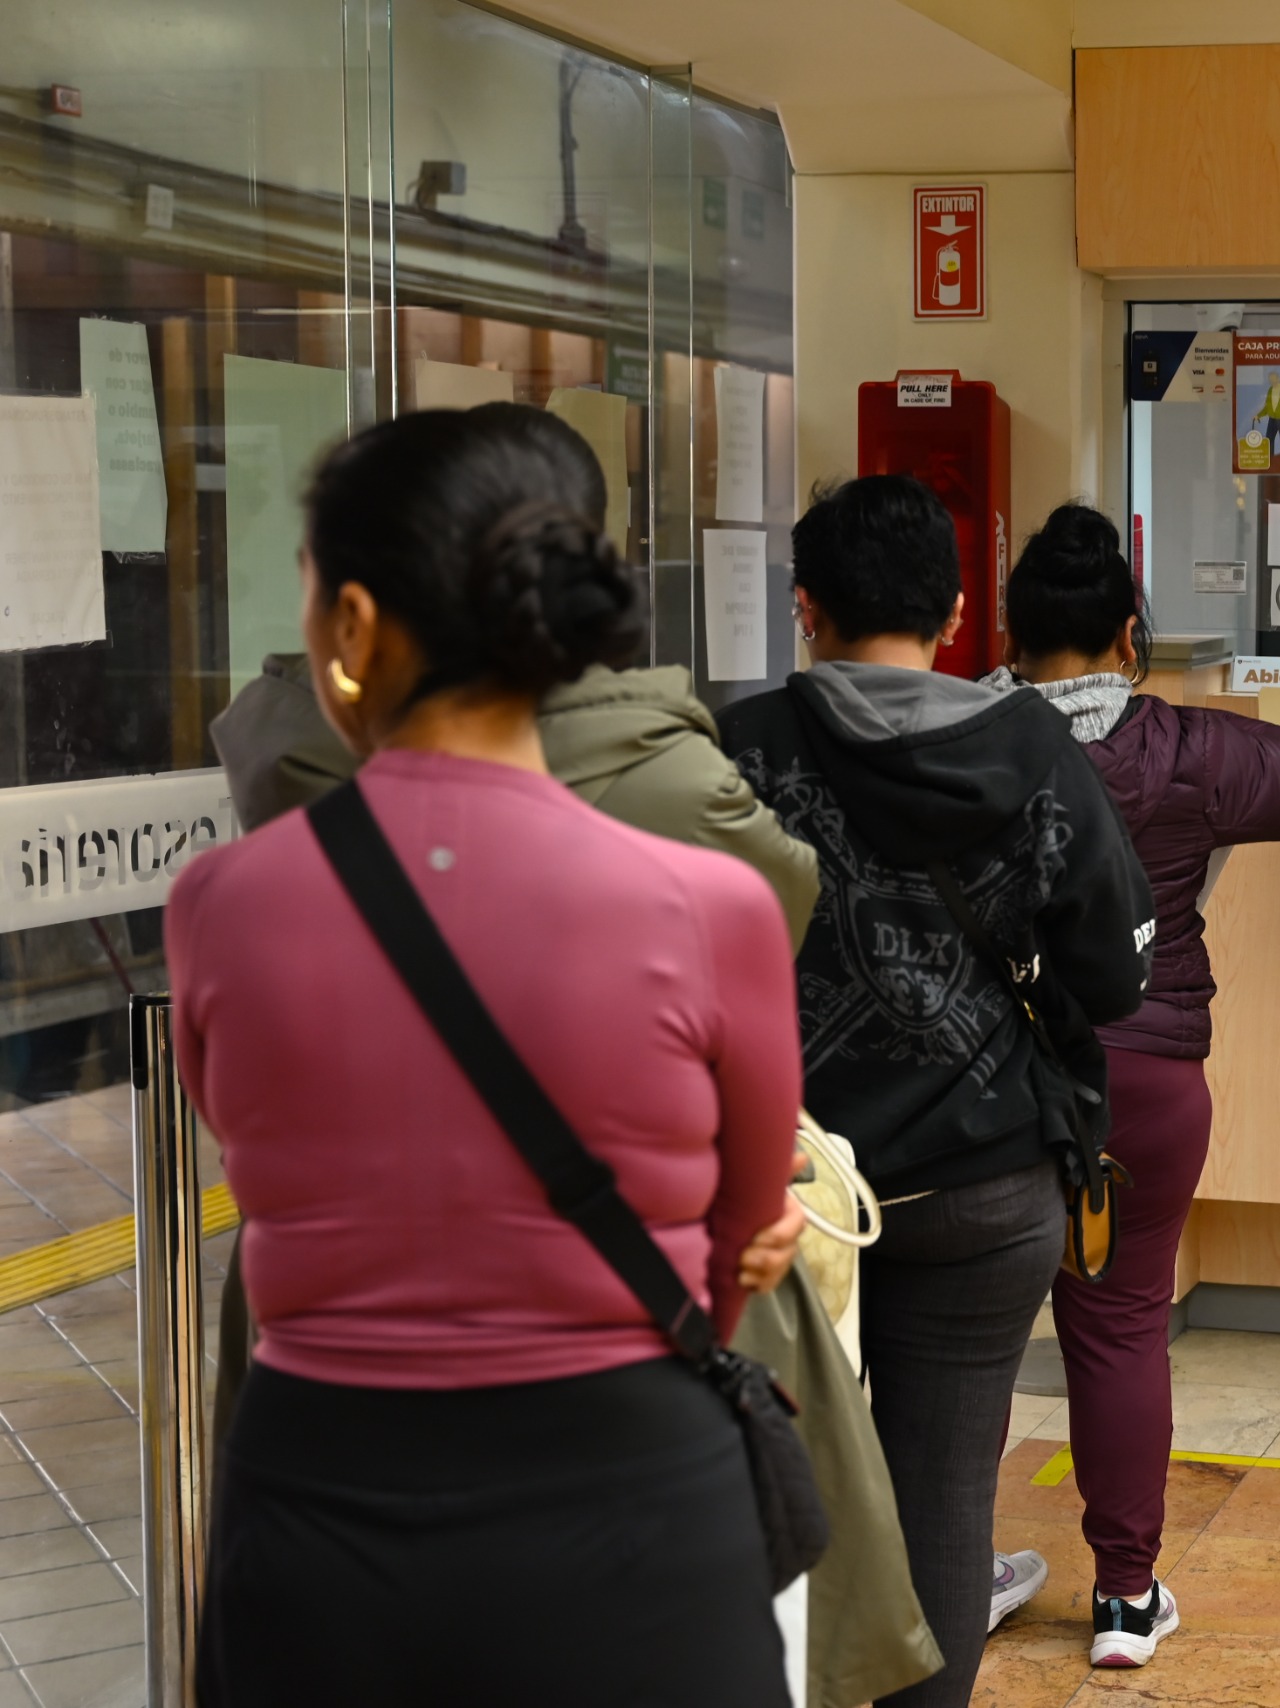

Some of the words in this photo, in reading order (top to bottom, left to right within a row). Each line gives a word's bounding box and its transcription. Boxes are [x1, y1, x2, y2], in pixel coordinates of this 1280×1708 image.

[922, 196, 975, 213] EXTINTOR
[1238, 342, 1264, 351] CAJA
[900, 384, 922, 392] PULL
[925, 384, 949, 392] HERE
[873, 921, 952, 966] DLX
